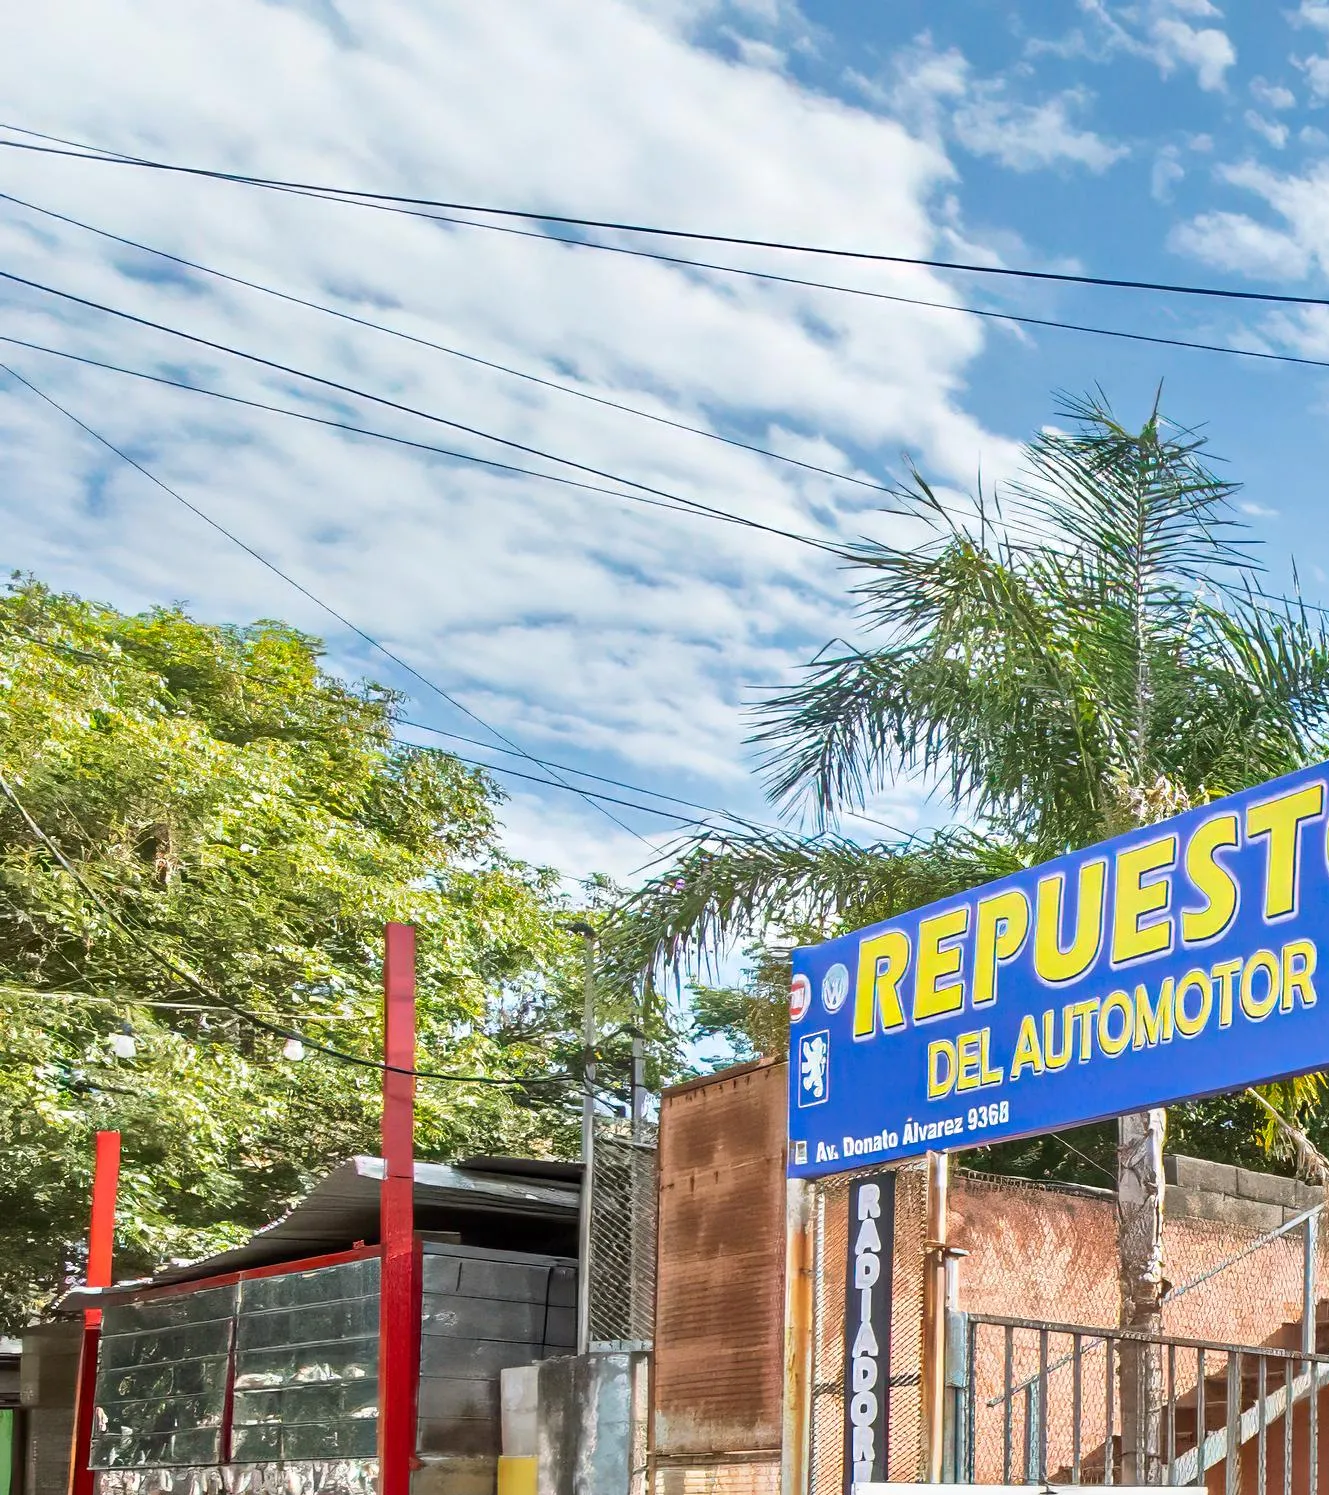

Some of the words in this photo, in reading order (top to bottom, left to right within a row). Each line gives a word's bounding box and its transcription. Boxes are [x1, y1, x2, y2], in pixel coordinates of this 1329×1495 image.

[926, 1026, 1005, 1102] DEL
[1009, 939, 1319, 1081] AUTOMOTOR
[815, 1141, 840, 1163] Av.
[842, 1128, 899, 1158] Donato
[902, 1116, 965, 1146] Álvarez
